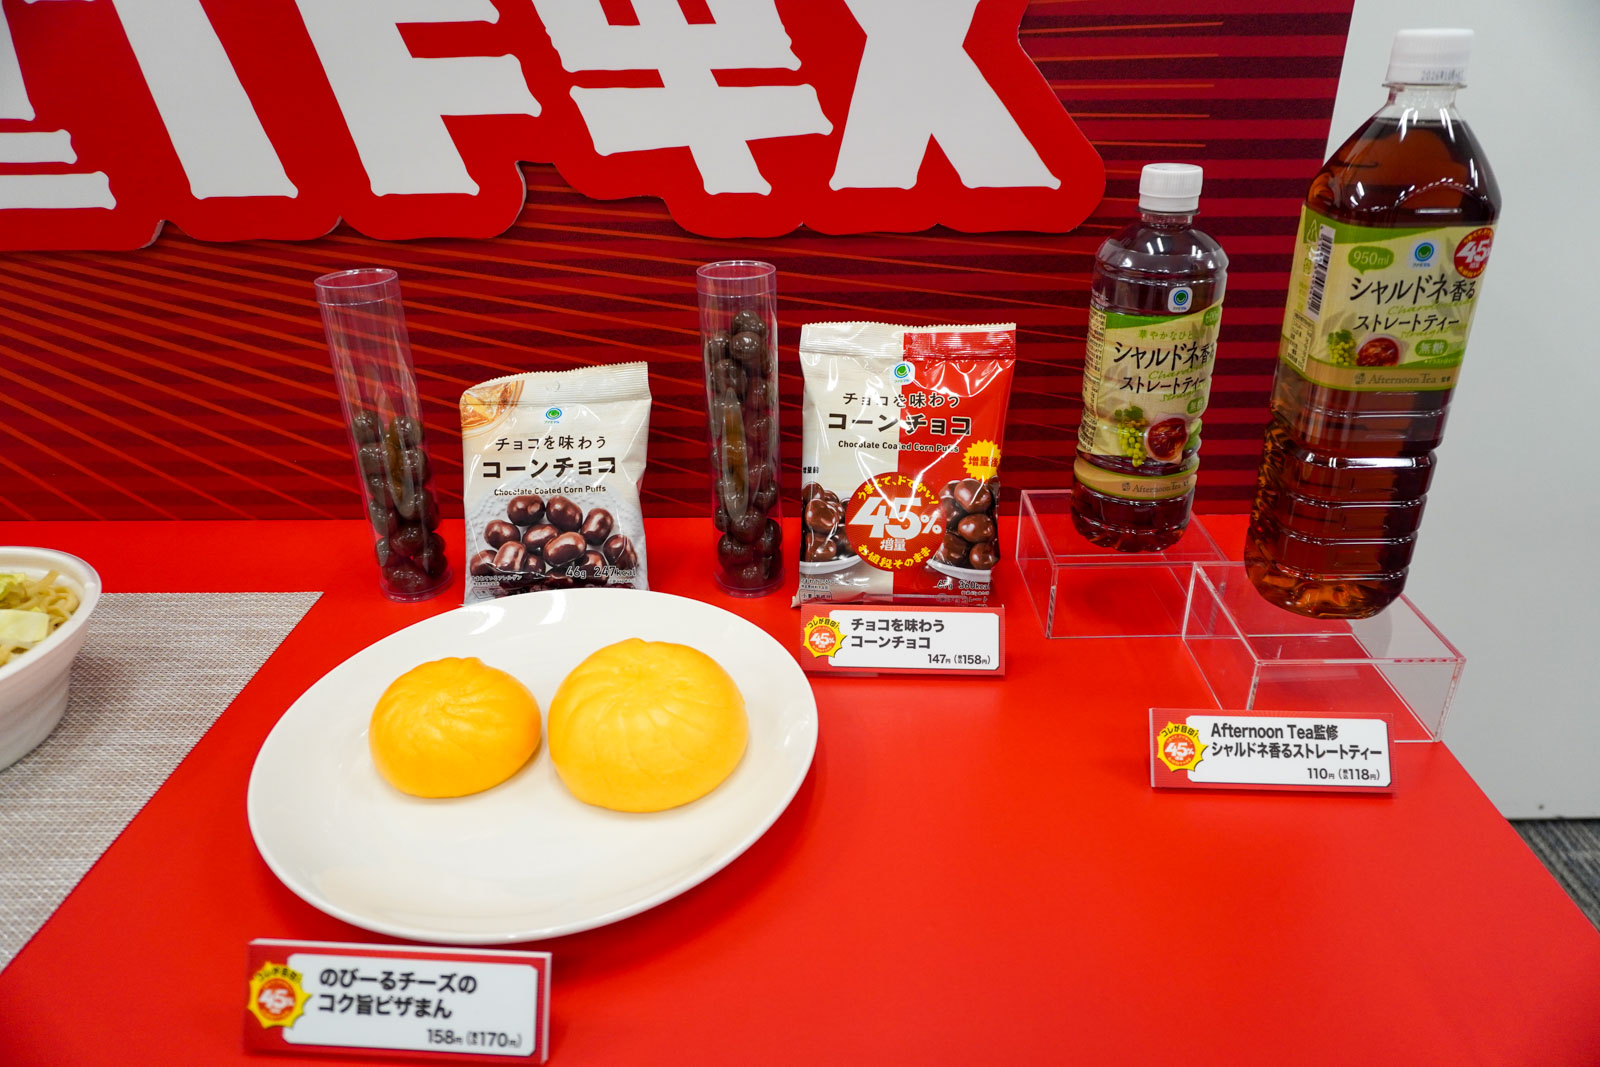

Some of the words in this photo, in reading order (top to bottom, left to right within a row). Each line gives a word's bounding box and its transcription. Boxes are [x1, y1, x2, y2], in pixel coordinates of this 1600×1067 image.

[1353, 251, 1389, 265] 950ml
[1350, 274, 1475, 305] シャルドネ香る
[1353, 313, 1460, 332] ストレートティー
[1120, 376, 1206, 394] ストレートティー
[1368, 374, 1419, 385] Afternoon
[1421, 373, 1437, 384] Tea
[828, 412, 972, 435] コーンチョコ
[495, 434, 606, 452] チョコを味わう
[914, 443, 934, 452] Corn
[483, 456, 616, 479] コーンチョコ
[534, 487, 562, 495] Coated
[564, 485, 583, 494] Corn
[848, 497, 942, 540] 45%
[880, 538, 906, 551] 増量
[858, 544, 931, 569] お値段そのまま
[566, 565, 586, 579] 46g
[851, 618, 945, 633] チョコを味わう
[851, 635, 931, 650] コーンチョコ
[1211, 723, 1284, 739] Afternoon
[1287, 724, 1338, 741] Tea監修
[1212, 742, 1382, 760] シャルドネ香るストレートティー
[320, 968, 477, 994] のびーるチーズの
[319, 993, 452, 1019] コク旨ピザまん
